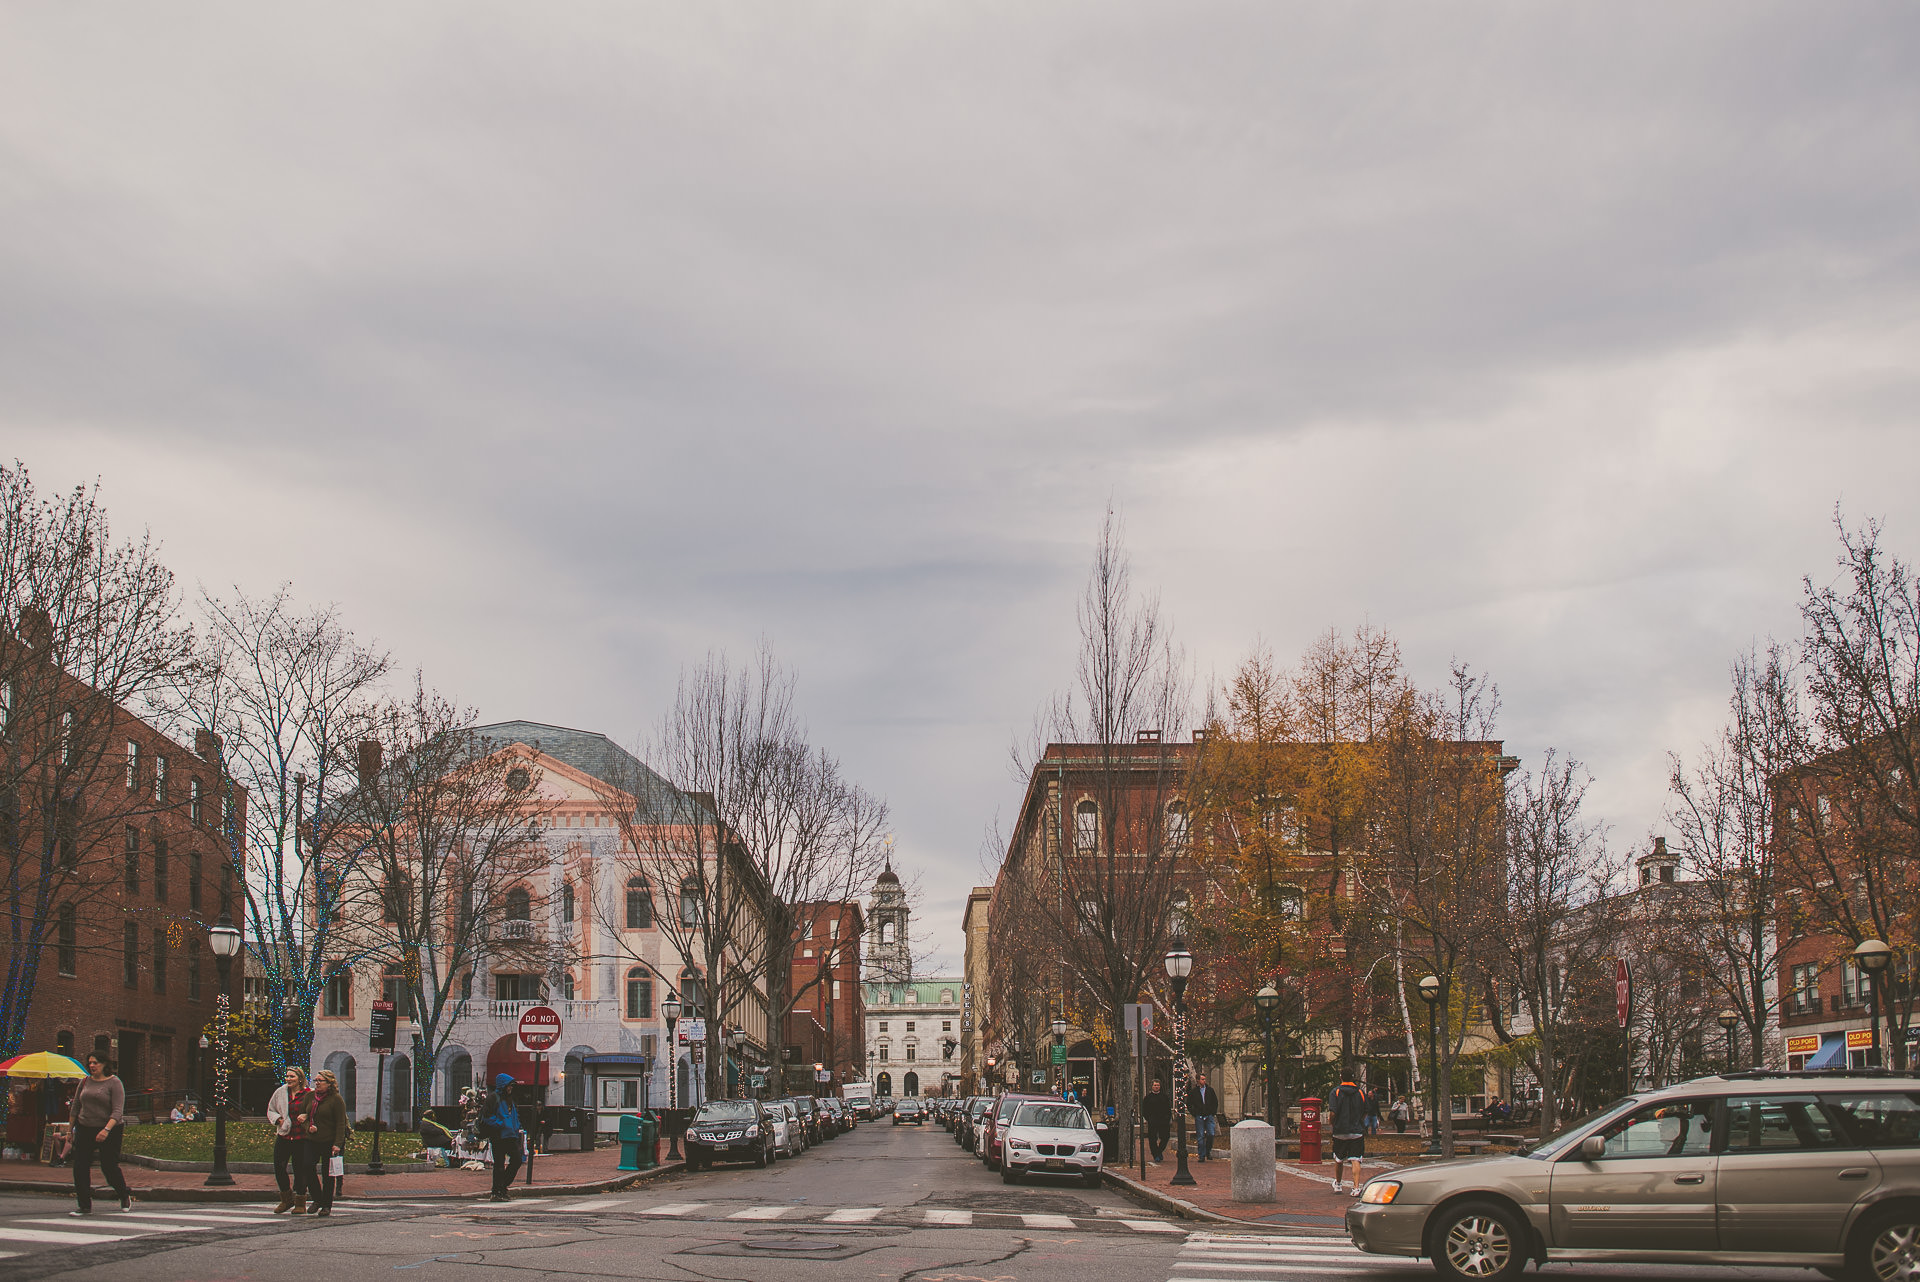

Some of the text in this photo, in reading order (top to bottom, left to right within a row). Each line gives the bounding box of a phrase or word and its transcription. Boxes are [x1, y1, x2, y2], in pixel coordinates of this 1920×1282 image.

[963, 983, 971, 1027] PRESS
[525, 1015, 556, 1023] DO NOT
[1848, 1033, 1860, 1041] OLD
